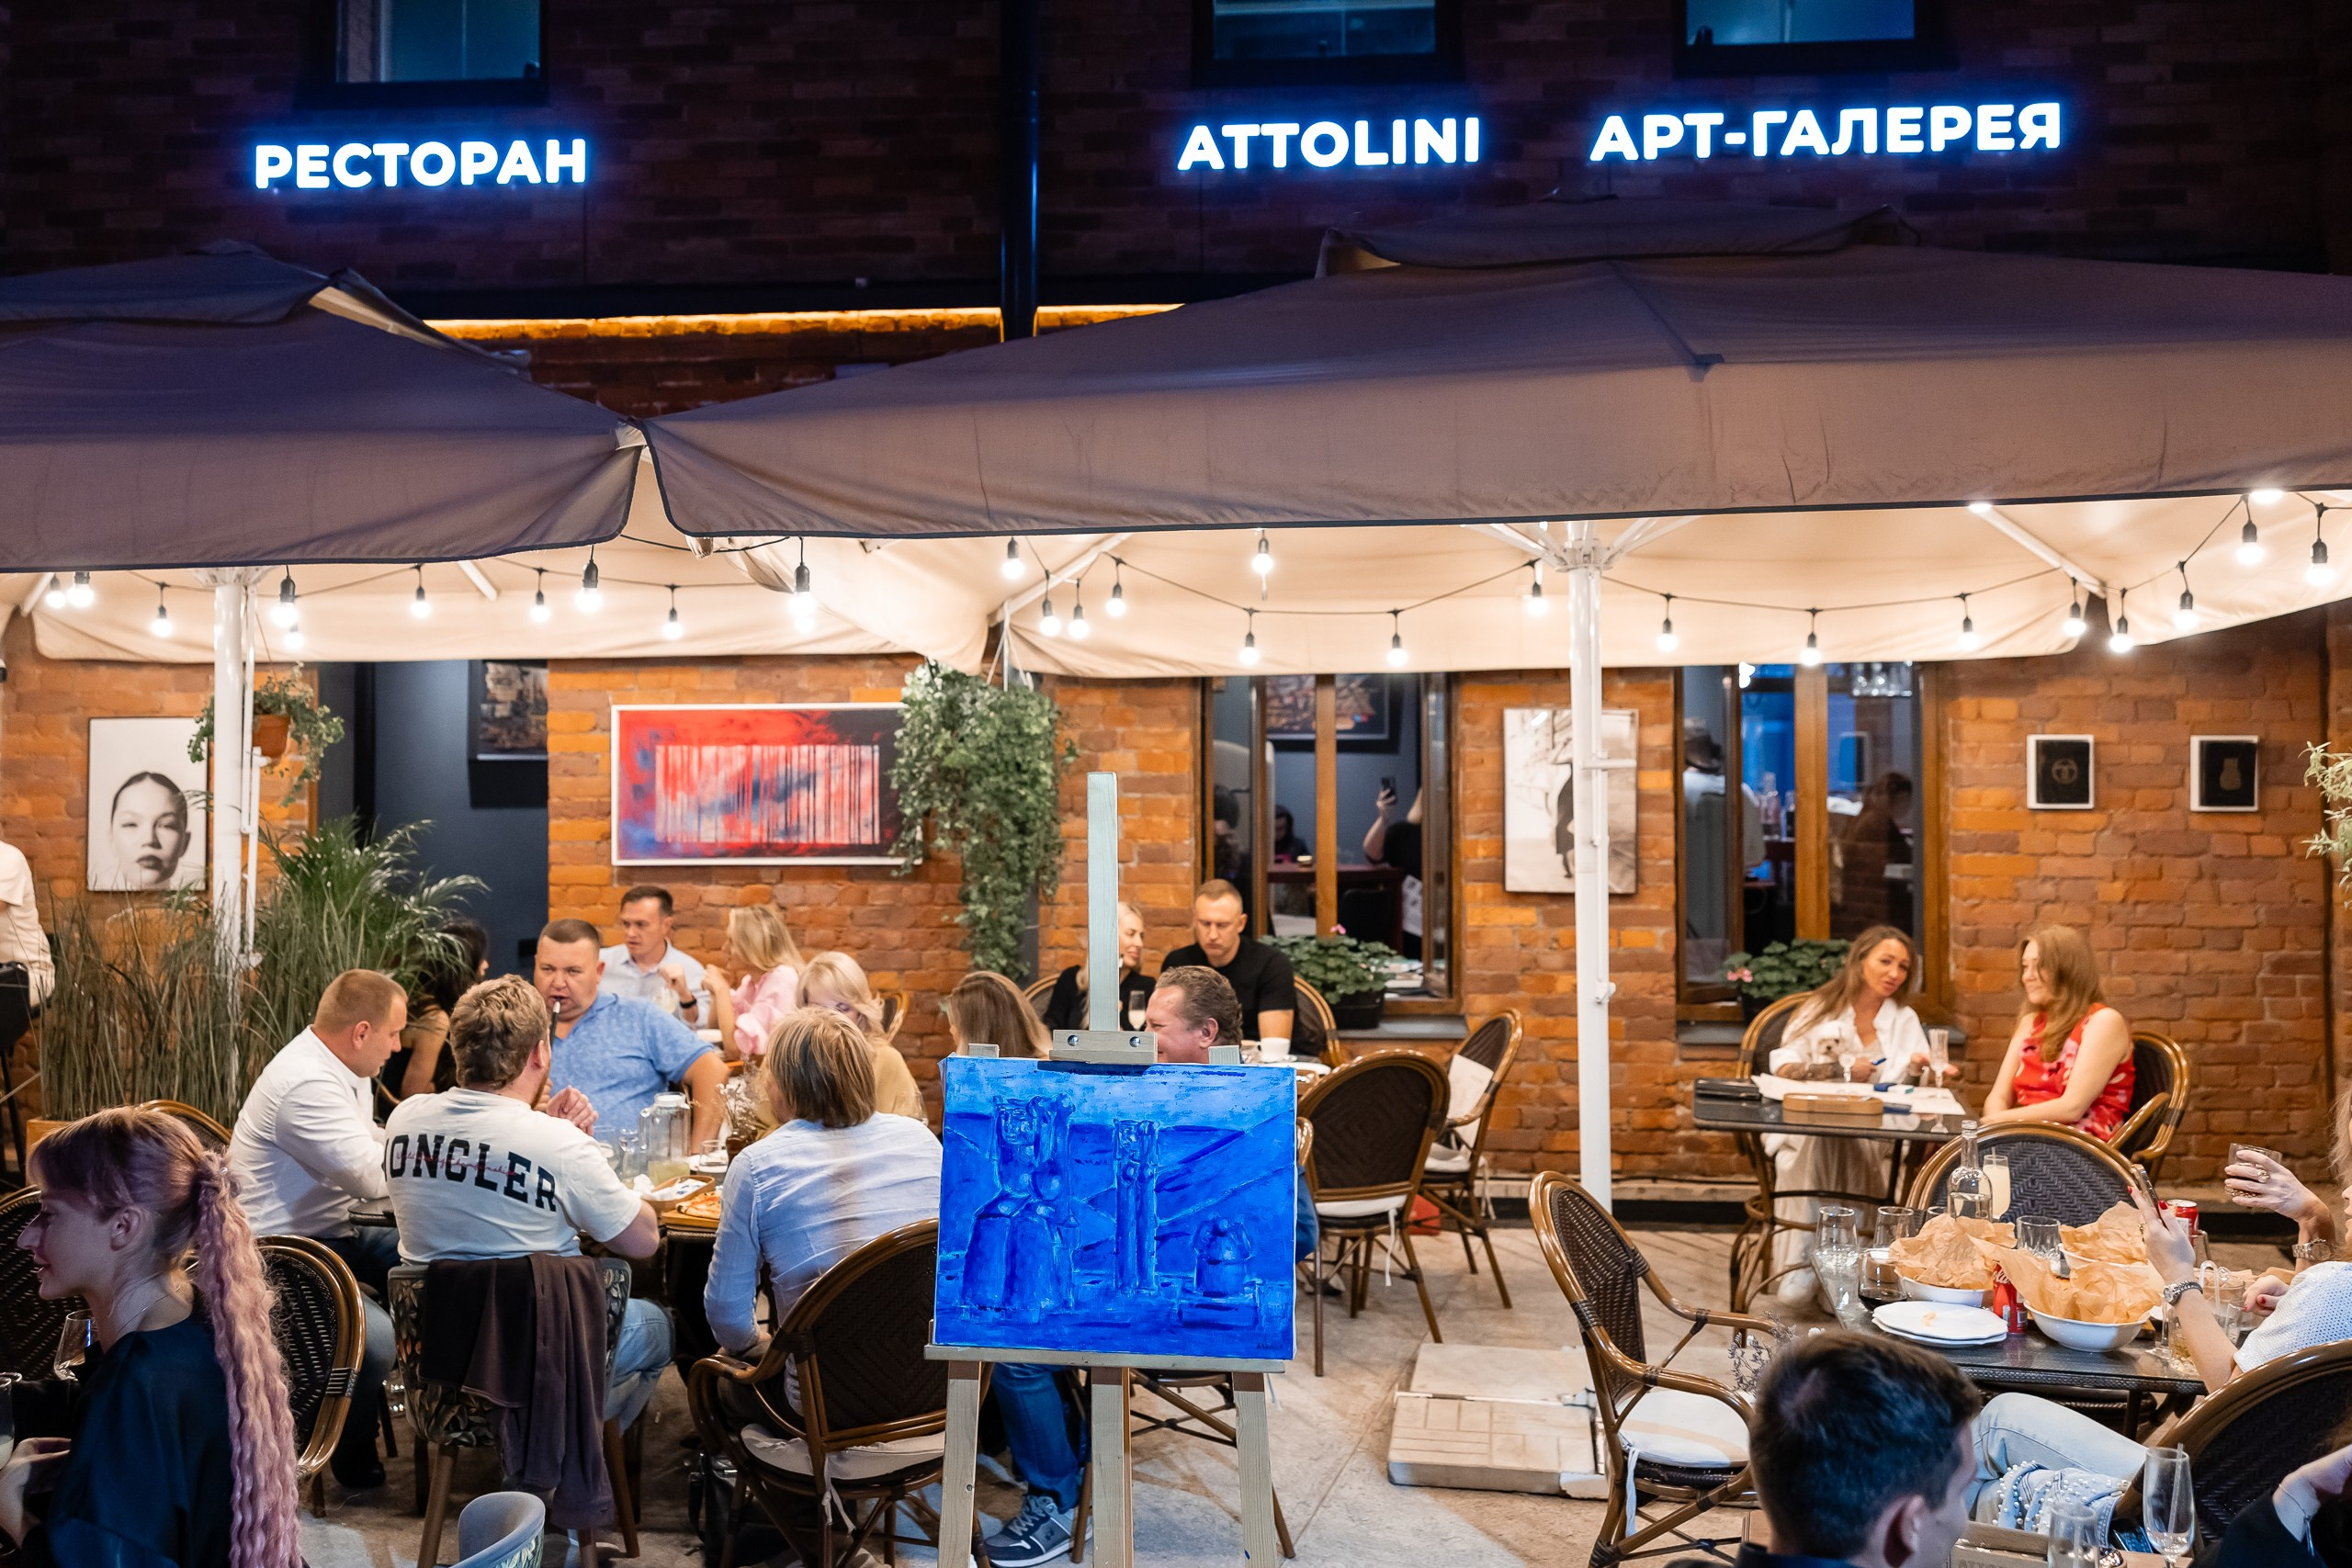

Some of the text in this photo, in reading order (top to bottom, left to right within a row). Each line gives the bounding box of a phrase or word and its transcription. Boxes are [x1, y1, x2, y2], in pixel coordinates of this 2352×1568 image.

[1177, 117, 1479, 171] ATTOLINI
[1589, 102, 2061, 162] АРТ-ГАЛЕРЕЯ
[255, 138, 586, 189] РЕСТОРАН
[382, 1134, 557, 1213] ONCLER
